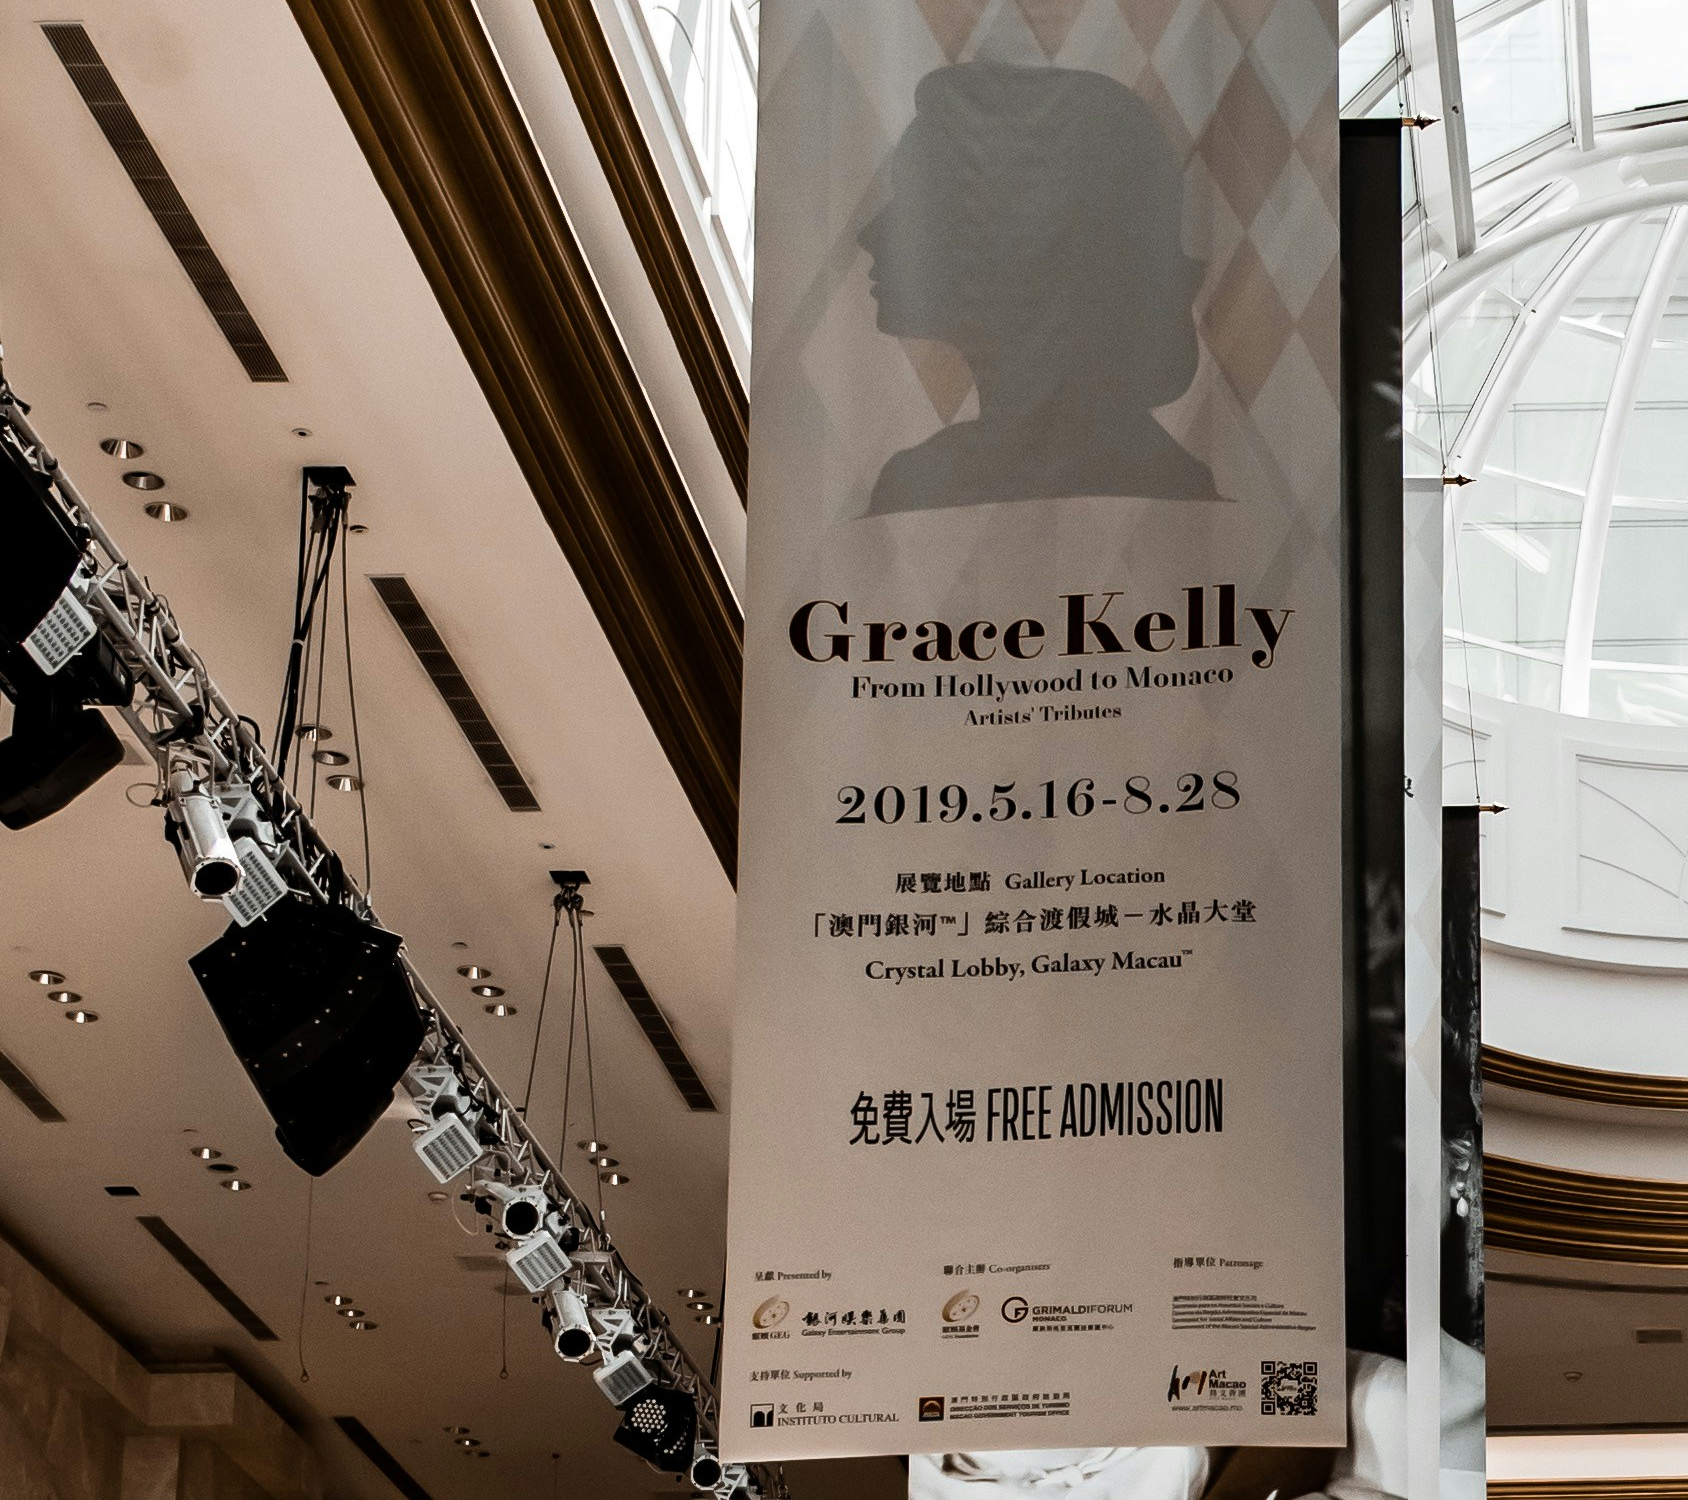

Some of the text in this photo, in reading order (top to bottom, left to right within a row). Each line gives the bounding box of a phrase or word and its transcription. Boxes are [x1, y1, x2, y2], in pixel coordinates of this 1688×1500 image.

[788, 584, 1296, 669] Grace Kelly
[851, 666, 1234, 702] From Hollywood to Monaco
[963, 704, 1122, 726] Artists' Tributes
[835, 771, 1240, 825] 2019.5.16-8.28
[895, 868, 1165, 893] 展覽地點 Gallery Location
[865, 959, 945, 985] Crystal
[951, 956, 1024, 982] Lobby,
[1031, 953, 1106, 977] Galaxy
[848, 1078, 1224, 1146] 免費入場 FREE ADMISSION
[1219, 1258, 1263, 1270] Patronage
[778, 1270, 820, 1281] Presented
[821, 1269, 832, 1281] by
[793, 1369, 840, 1382] Supported
[841, 1369, 853, 1380] by
[1209, 1369, 1226, 1379] Art
[1208, 1379, 1247, 1389] Macao
[778, 1402, 824, 1414] 文化局
[777, 1413, 900, 1427] INSTITUTO CULTURAL
